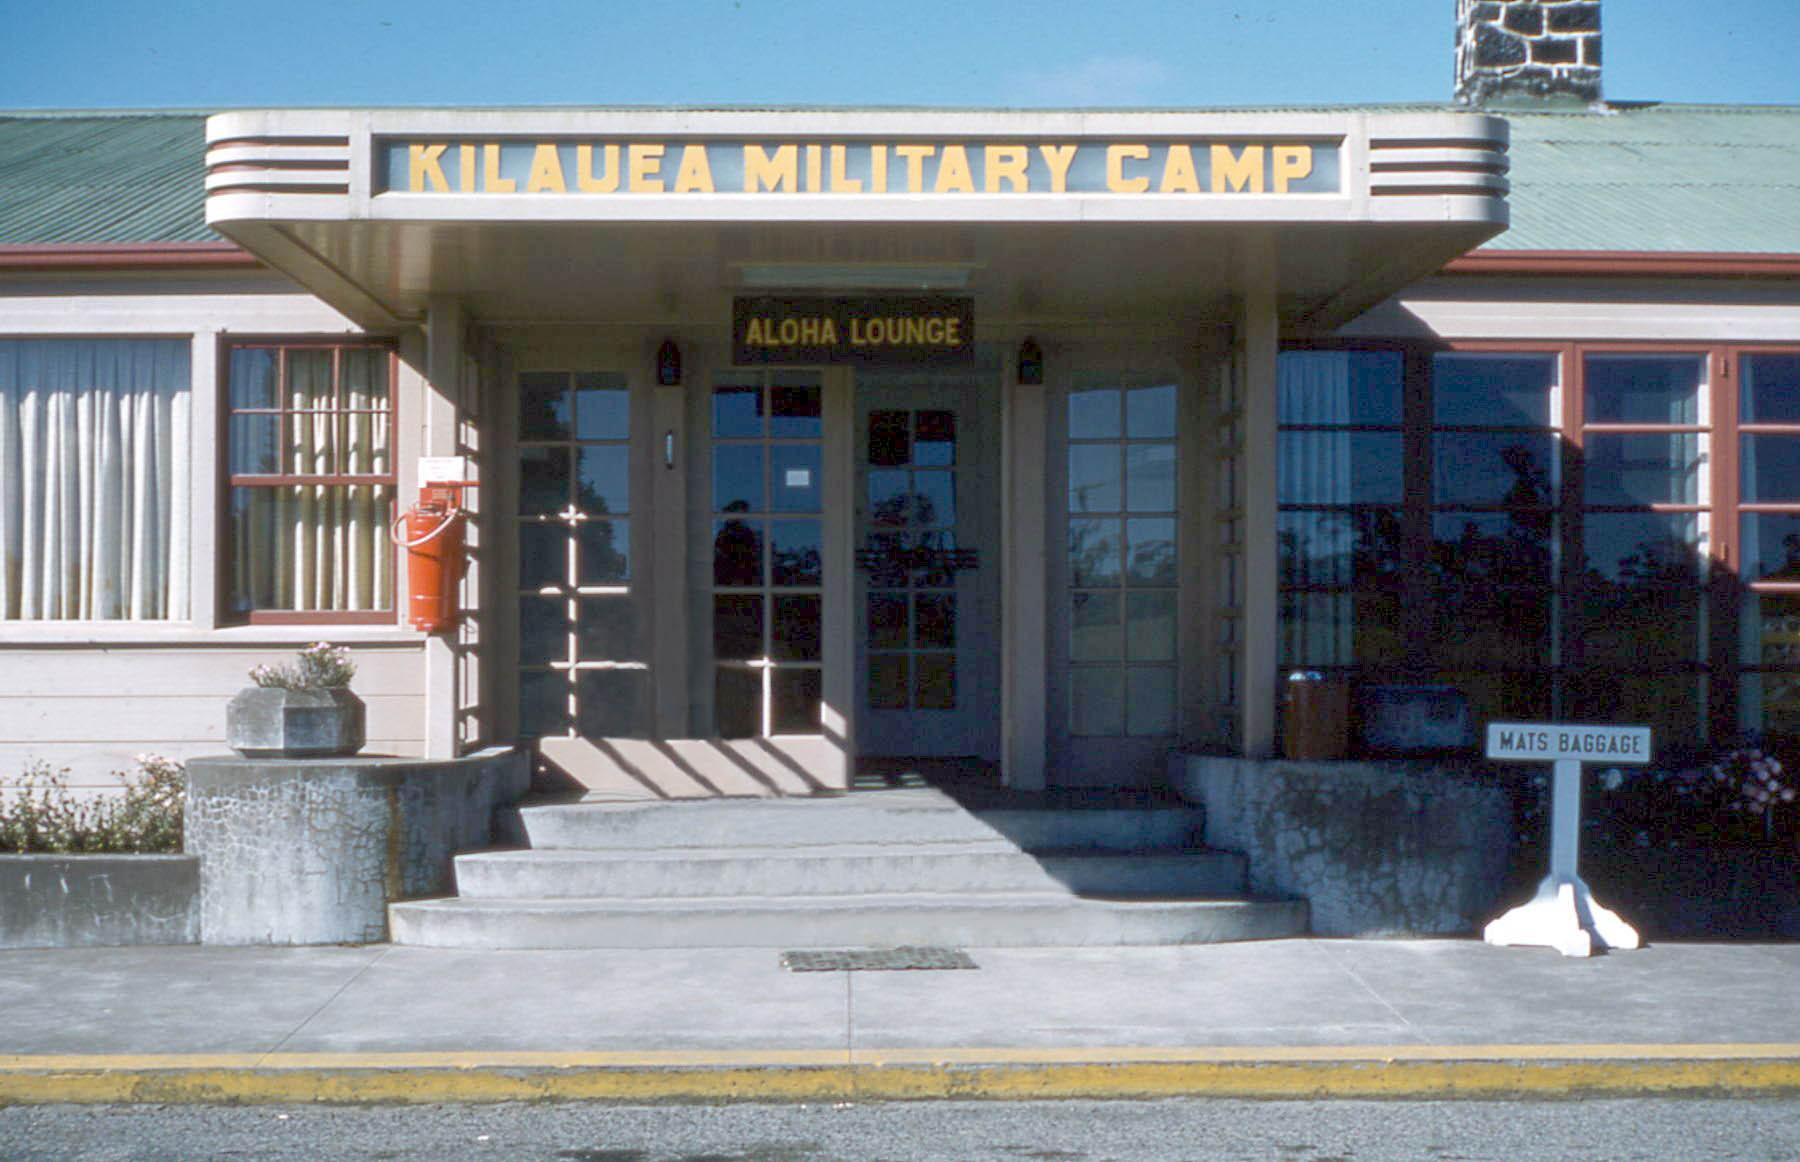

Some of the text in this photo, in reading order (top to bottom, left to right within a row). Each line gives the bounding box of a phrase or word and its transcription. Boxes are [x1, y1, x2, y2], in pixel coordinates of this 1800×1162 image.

[408, 143, 1313, 193] KILAUEA MILITARY CAMP
[746, 317, 961, 345] ALOHA LOUNGE
[1499, 731, 1641, 754] MATS BAGGAGE
